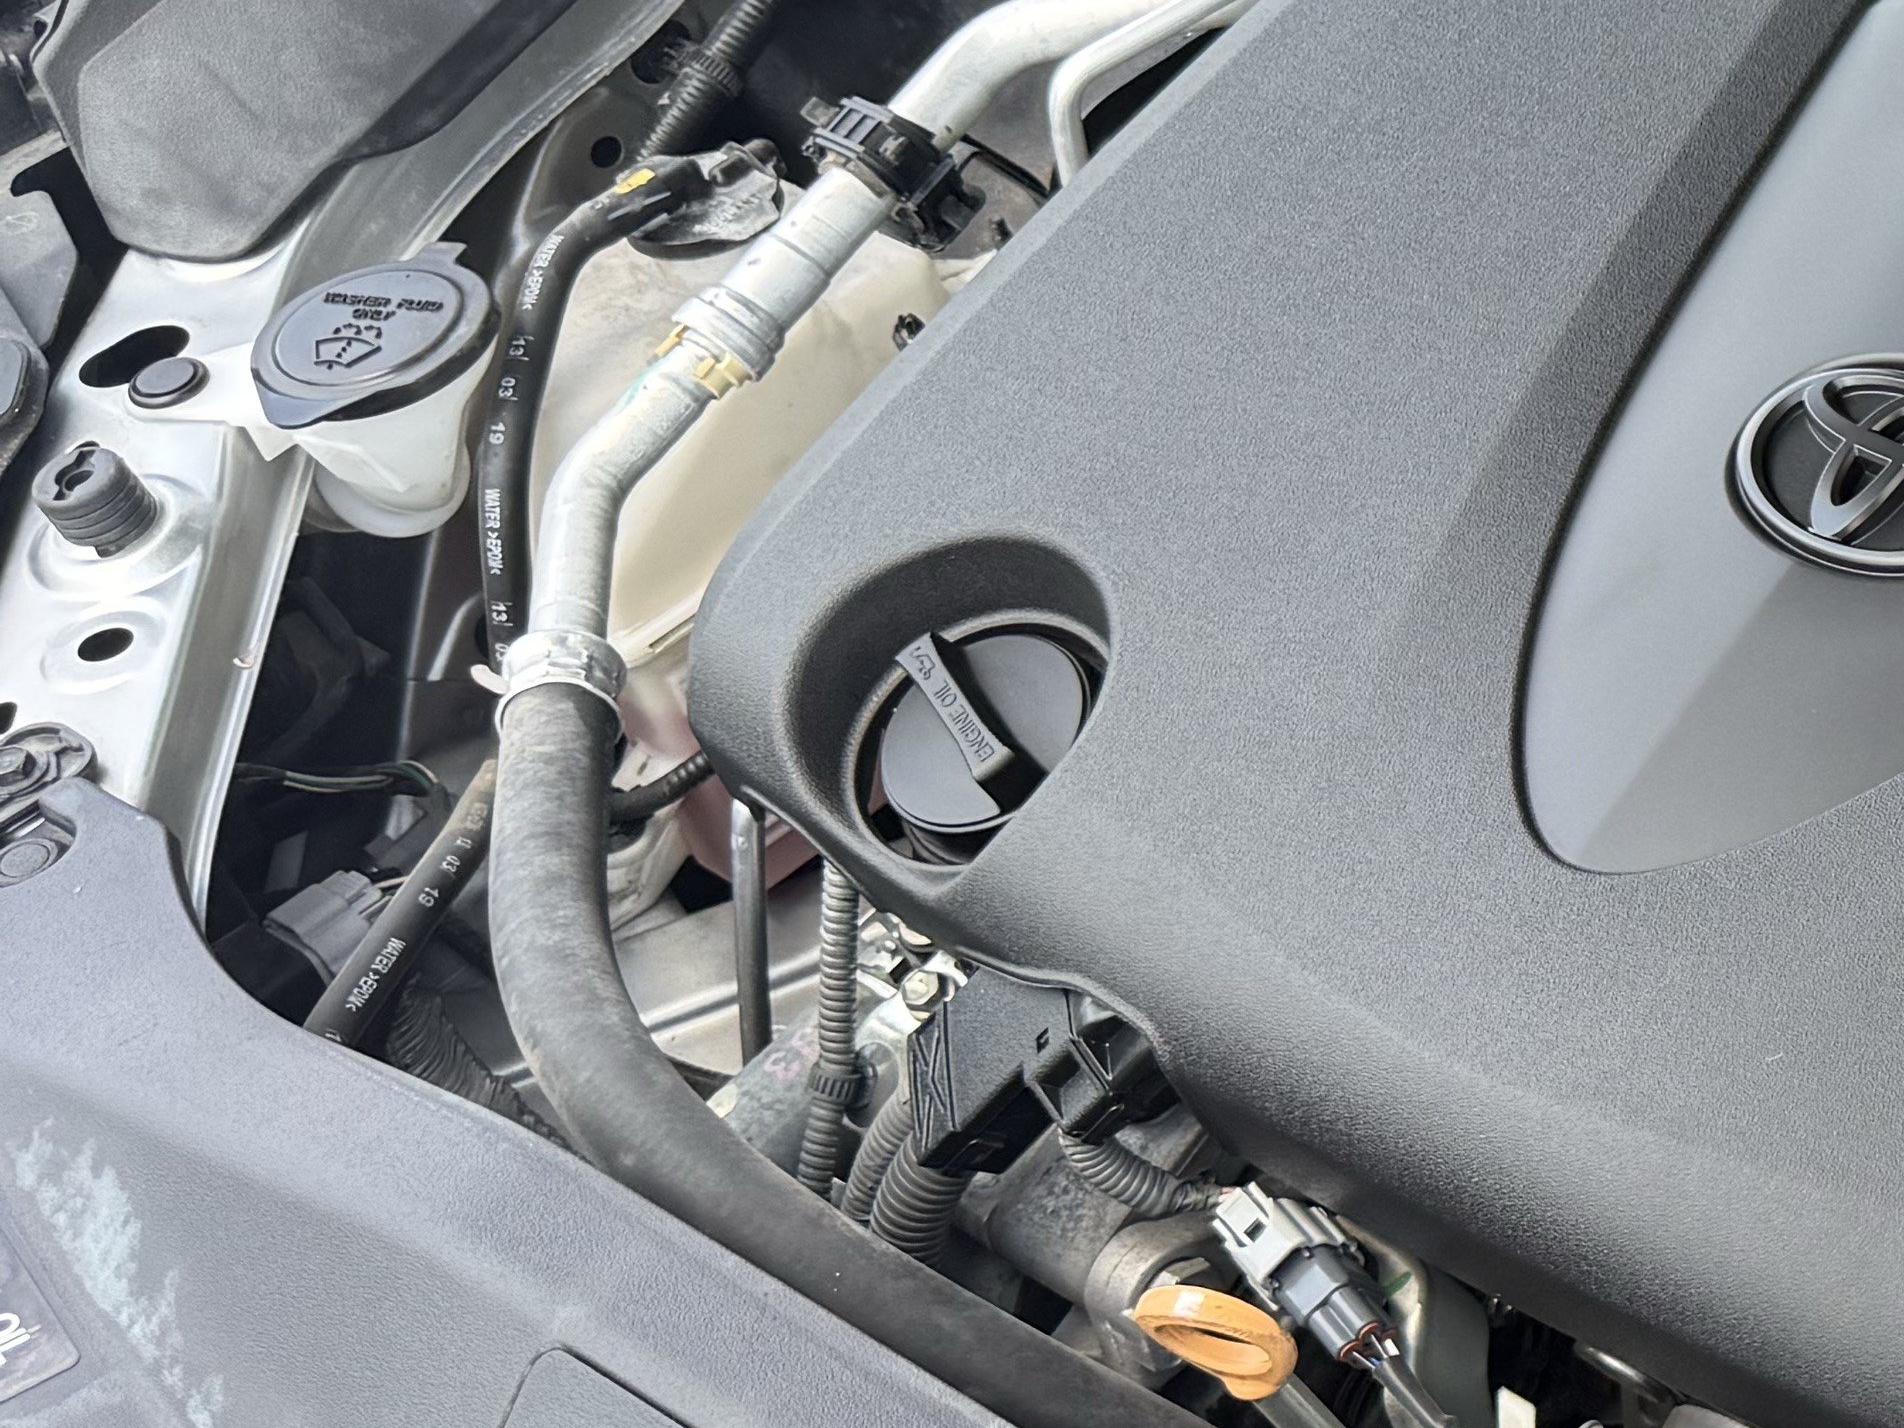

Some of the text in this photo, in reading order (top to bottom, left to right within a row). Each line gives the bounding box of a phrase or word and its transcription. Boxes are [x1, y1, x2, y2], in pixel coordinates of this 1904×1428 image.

[484, 487, 502, 529] WATER
[933, 678, 996, 763] ENGINE OIL
